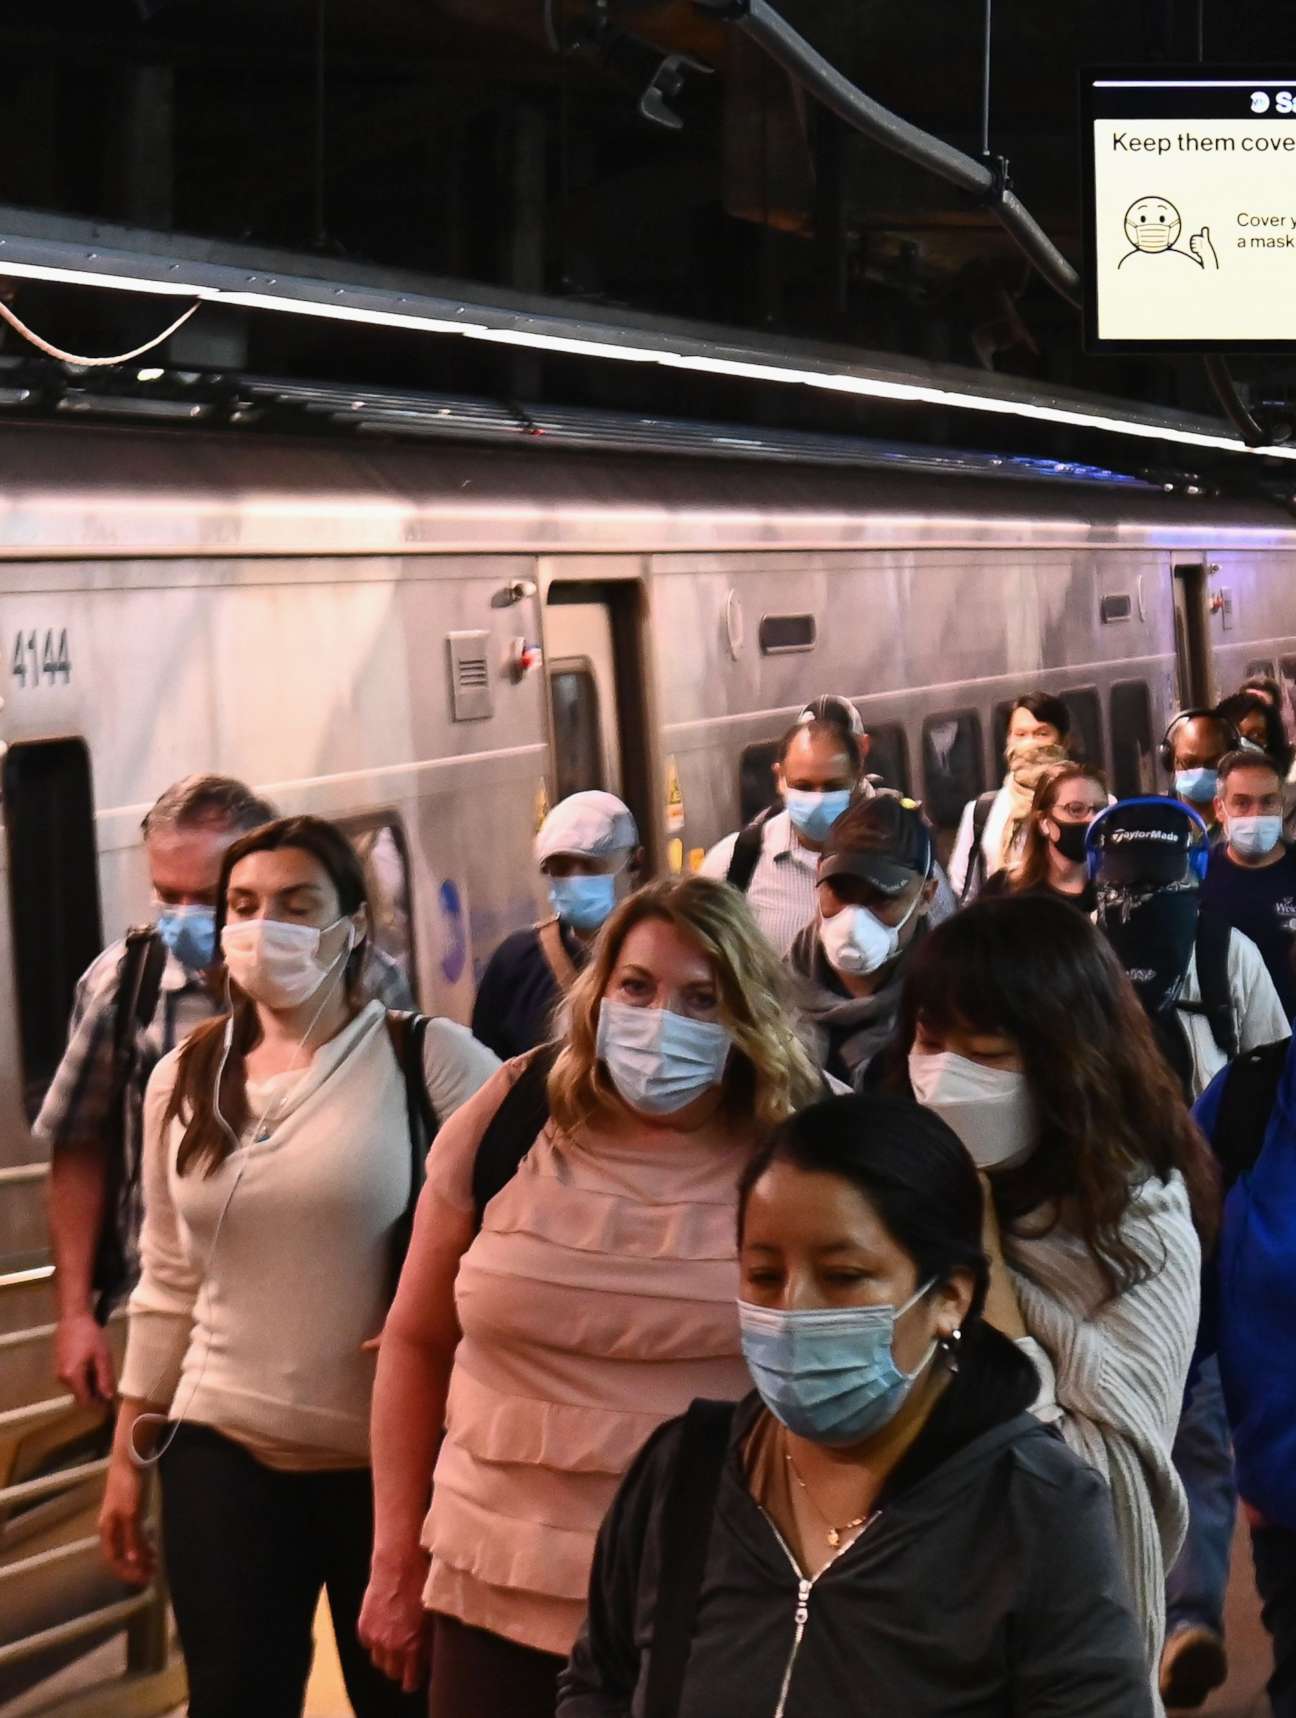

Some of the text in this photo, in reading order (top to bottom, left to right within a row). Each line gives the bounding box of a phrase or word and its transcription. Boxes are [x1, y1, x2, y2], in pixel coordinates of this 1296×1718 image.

[1113, 132, 1172, 156] Keep
[1177, 132, 1235, 152] them
[1236, 212, 1286, 227] Cover
[1236, 237, 1246, 249] a
[1250, 234, 1295, 249] mask
[13, 626, 71, 688] 4144
[1111, 828, 1180, 845] TaylorMade
